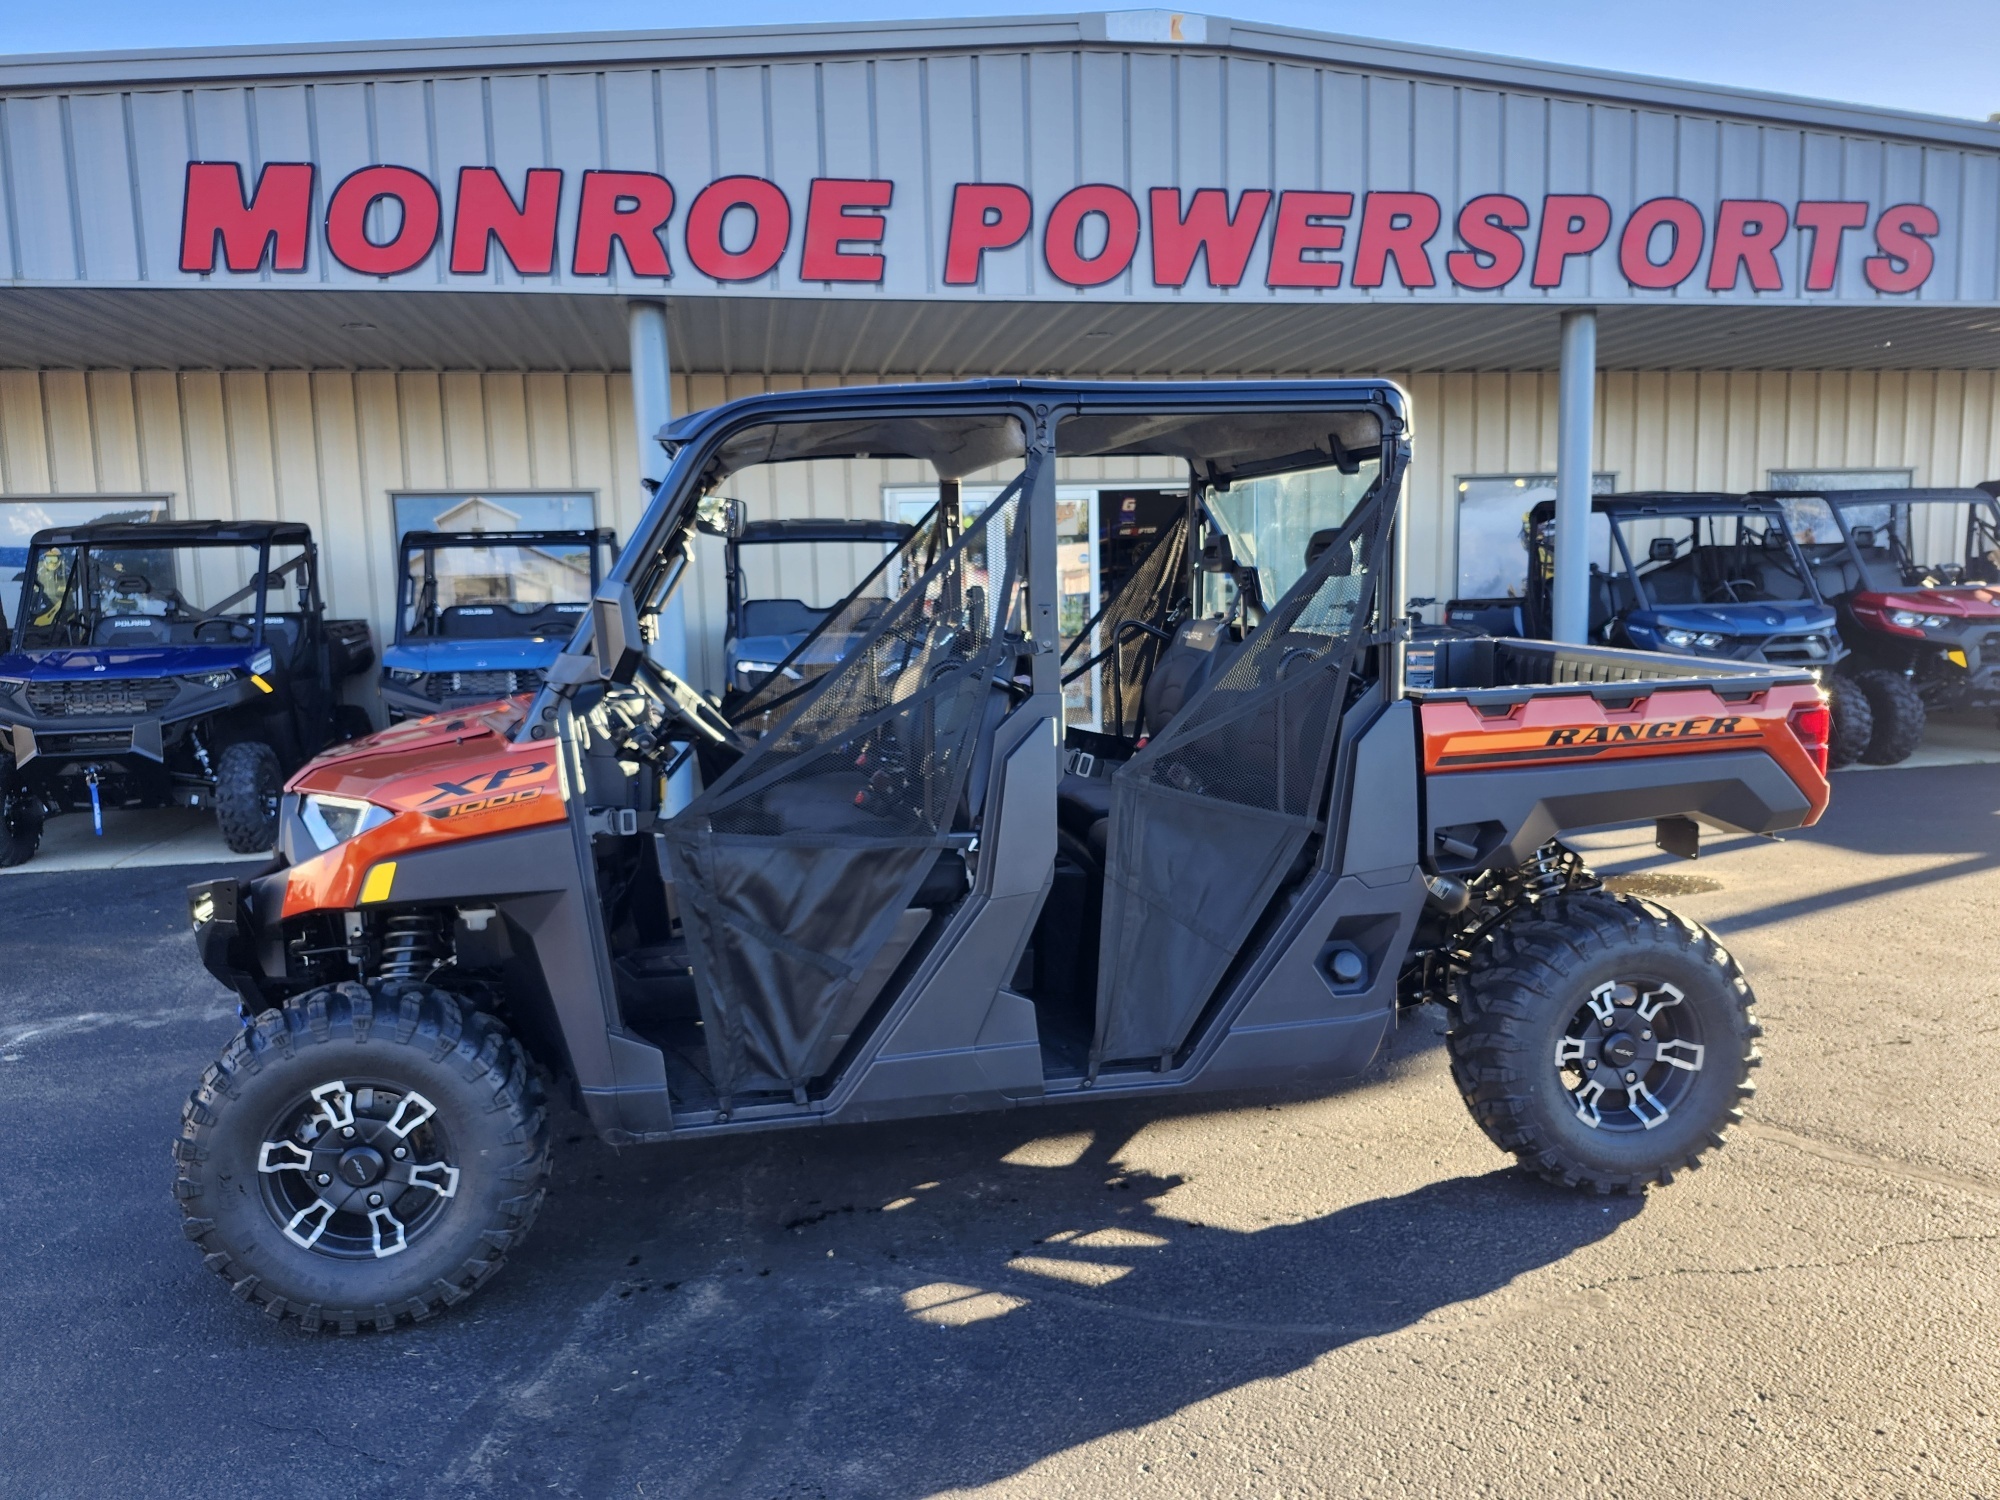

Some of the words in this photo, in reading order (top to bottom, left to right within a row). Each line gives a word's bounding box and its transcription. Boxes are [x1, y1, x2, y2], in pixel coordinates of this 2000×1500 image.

[180, 160, 894, 284] MONROE
[943, 182, 1940, 295] POWERSPORTS
[114, 619, 152, 628] POLARIS
[248, 616, 285, 625] PARIS
[50, 691, 144, 703] POLARIS
[1545, 716, 1744, 747] RANGER
[416, 761, 550, 806] XP
[448, 785, 545, 818] 1000
